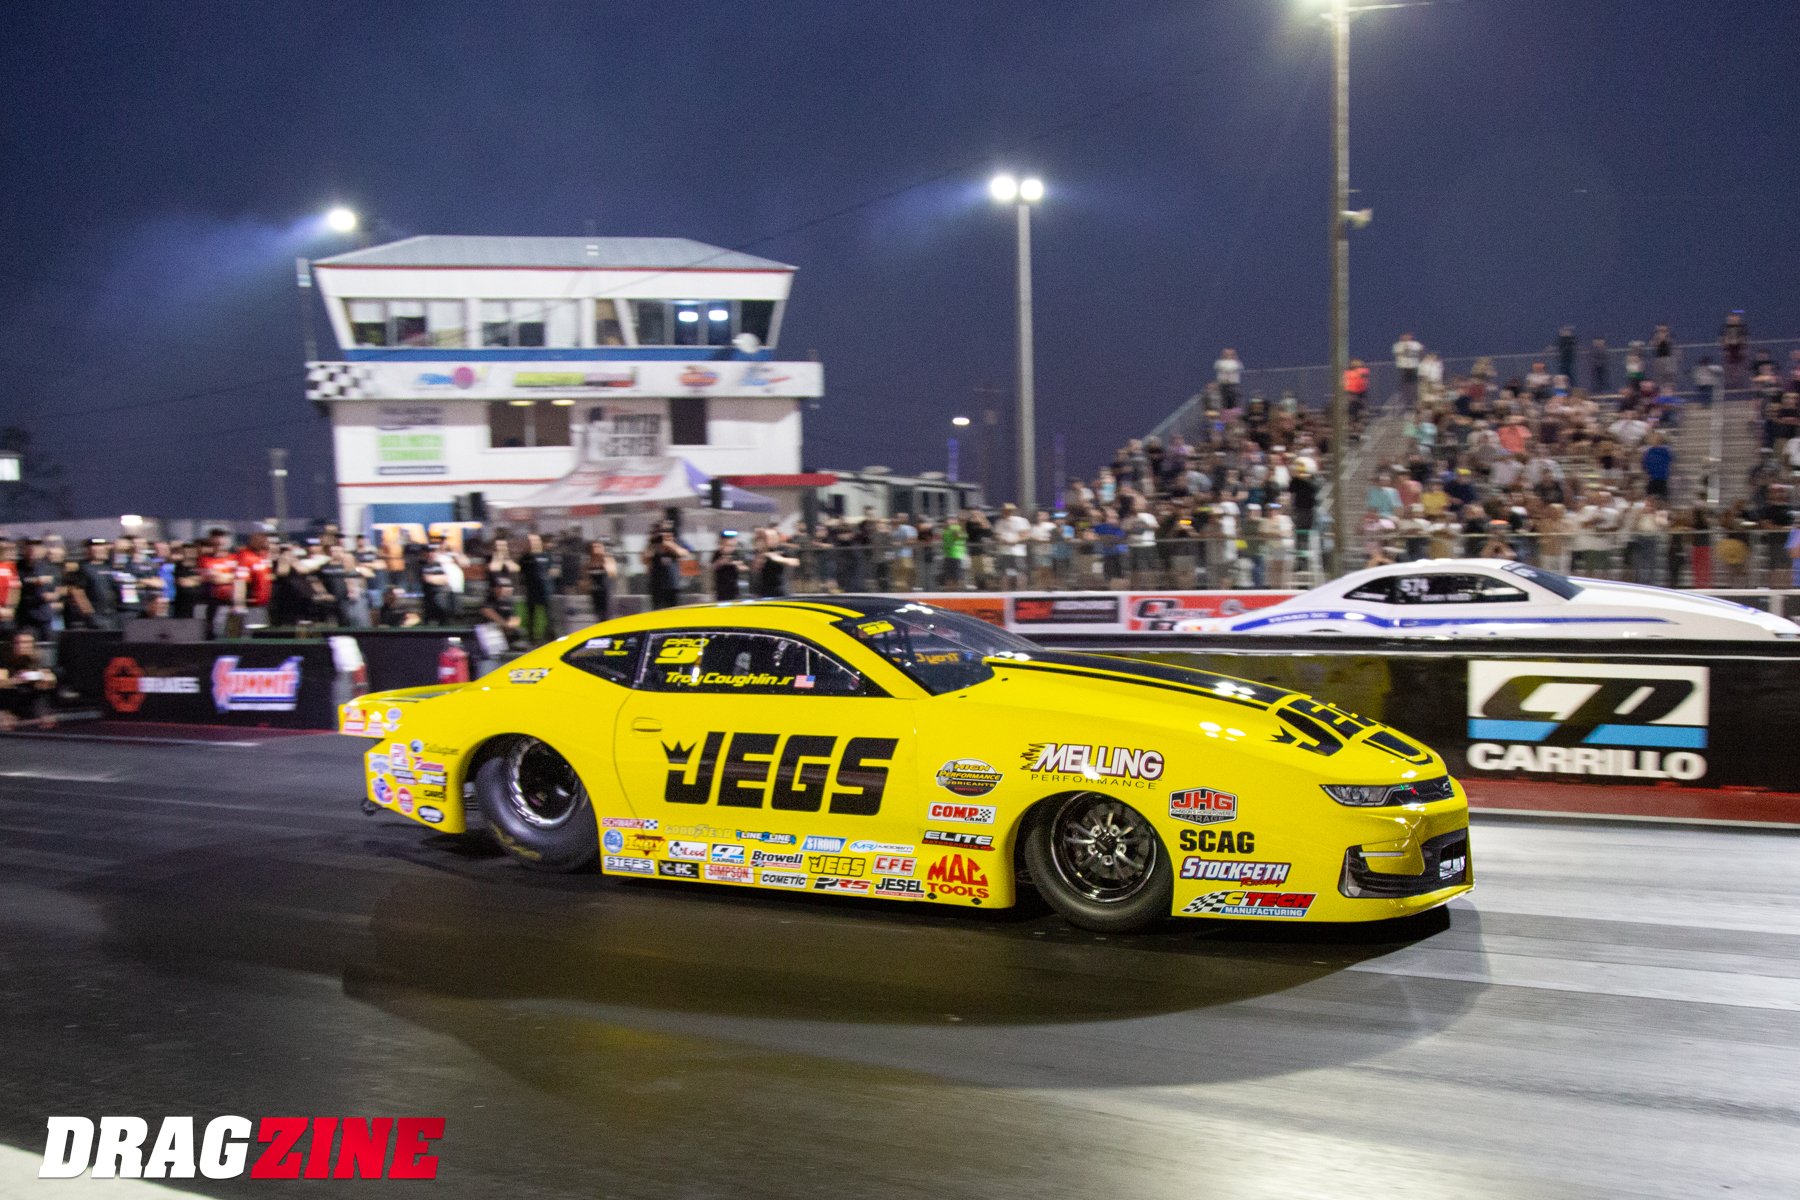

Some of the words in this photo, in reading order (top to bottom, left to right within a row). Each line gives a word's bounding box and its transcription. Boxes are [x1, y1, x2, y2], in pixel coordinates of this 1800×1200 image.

[1401, 579, 1429, 592] 574
[662, 638, 709, 648] PRO
[665, 671, 699, 687] Troy
[702, 672, 779, 686] Coughlin
[953, 763, 990, 771] HIGH
[1031, 743, 1164, 780] MELLING
[1467, 742, 1707, 780] CARRILLO
[663, 731, 900, 817] JEGS
[939, 771, 1001, 781] PERFORMANCE
[1031, 774, 1156, 789] PERFORMANCE
[1173, 791, 1233, 811] JHG
[931, 805, 979, 819] COMP
[806, 837, 841, 852] STROUD
[924, 830, 993, 846] ELITE
[1180, 829, 1255, 854] SCAG
[752, 851, 803, 864] Browell
[876, 857, 914, 872] CFE
[708, 864, 749, 878] SIMPSON
[811, 854, 866, 877] JEGS
[927, 854, 988, 887] MAC
[1182, 857, 1290, 882] STOCKSETH
[761, 874, 806, 885] COMETIC
[875, 878, 924, 893] JESEL
[927, 882, 990, 899] TOOLS
[1225, 906, 1303, 917] MANUFACTURING
